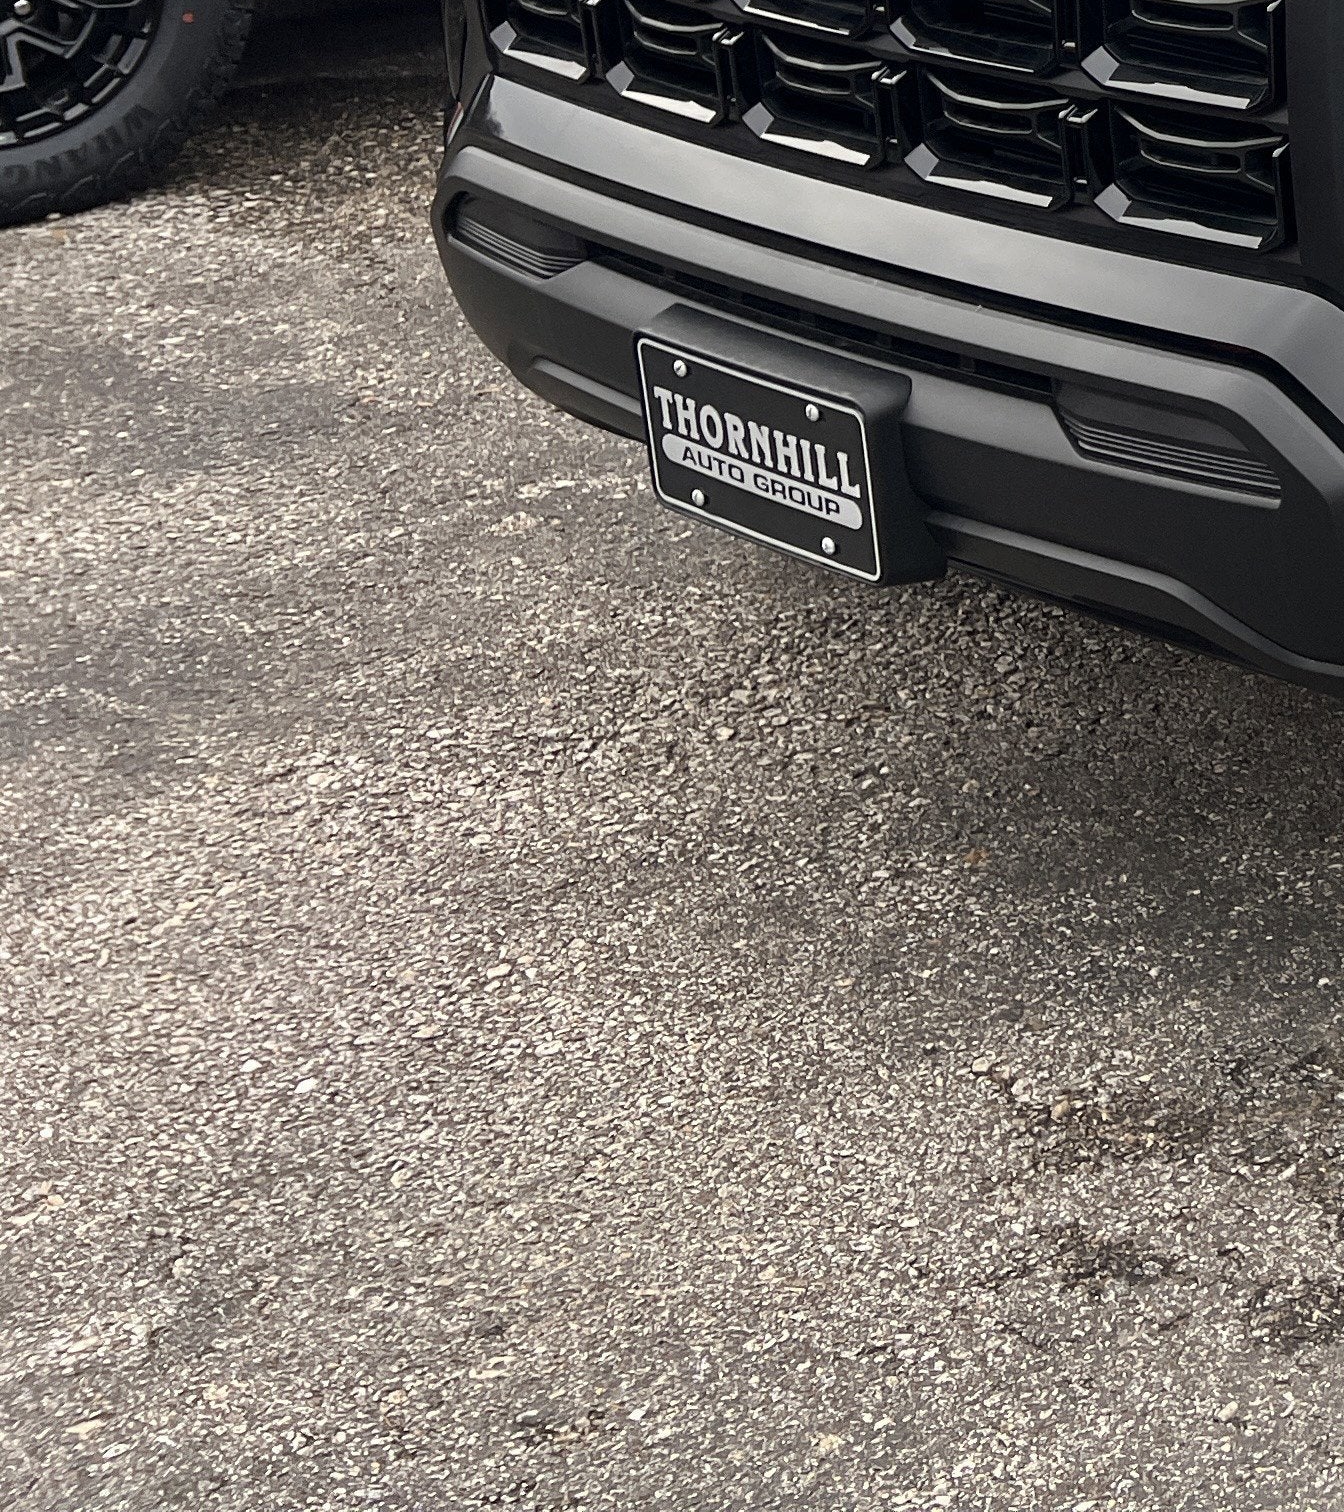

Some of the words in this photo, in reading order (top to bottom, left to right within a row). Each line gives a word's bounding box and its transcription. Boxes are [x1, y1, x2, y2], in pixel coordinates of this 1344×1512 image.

[653, 386, 861, 499] THORNHILL
[682, 446, 745, 484] AUTO
[753, 472, 840, 516] GROUP
